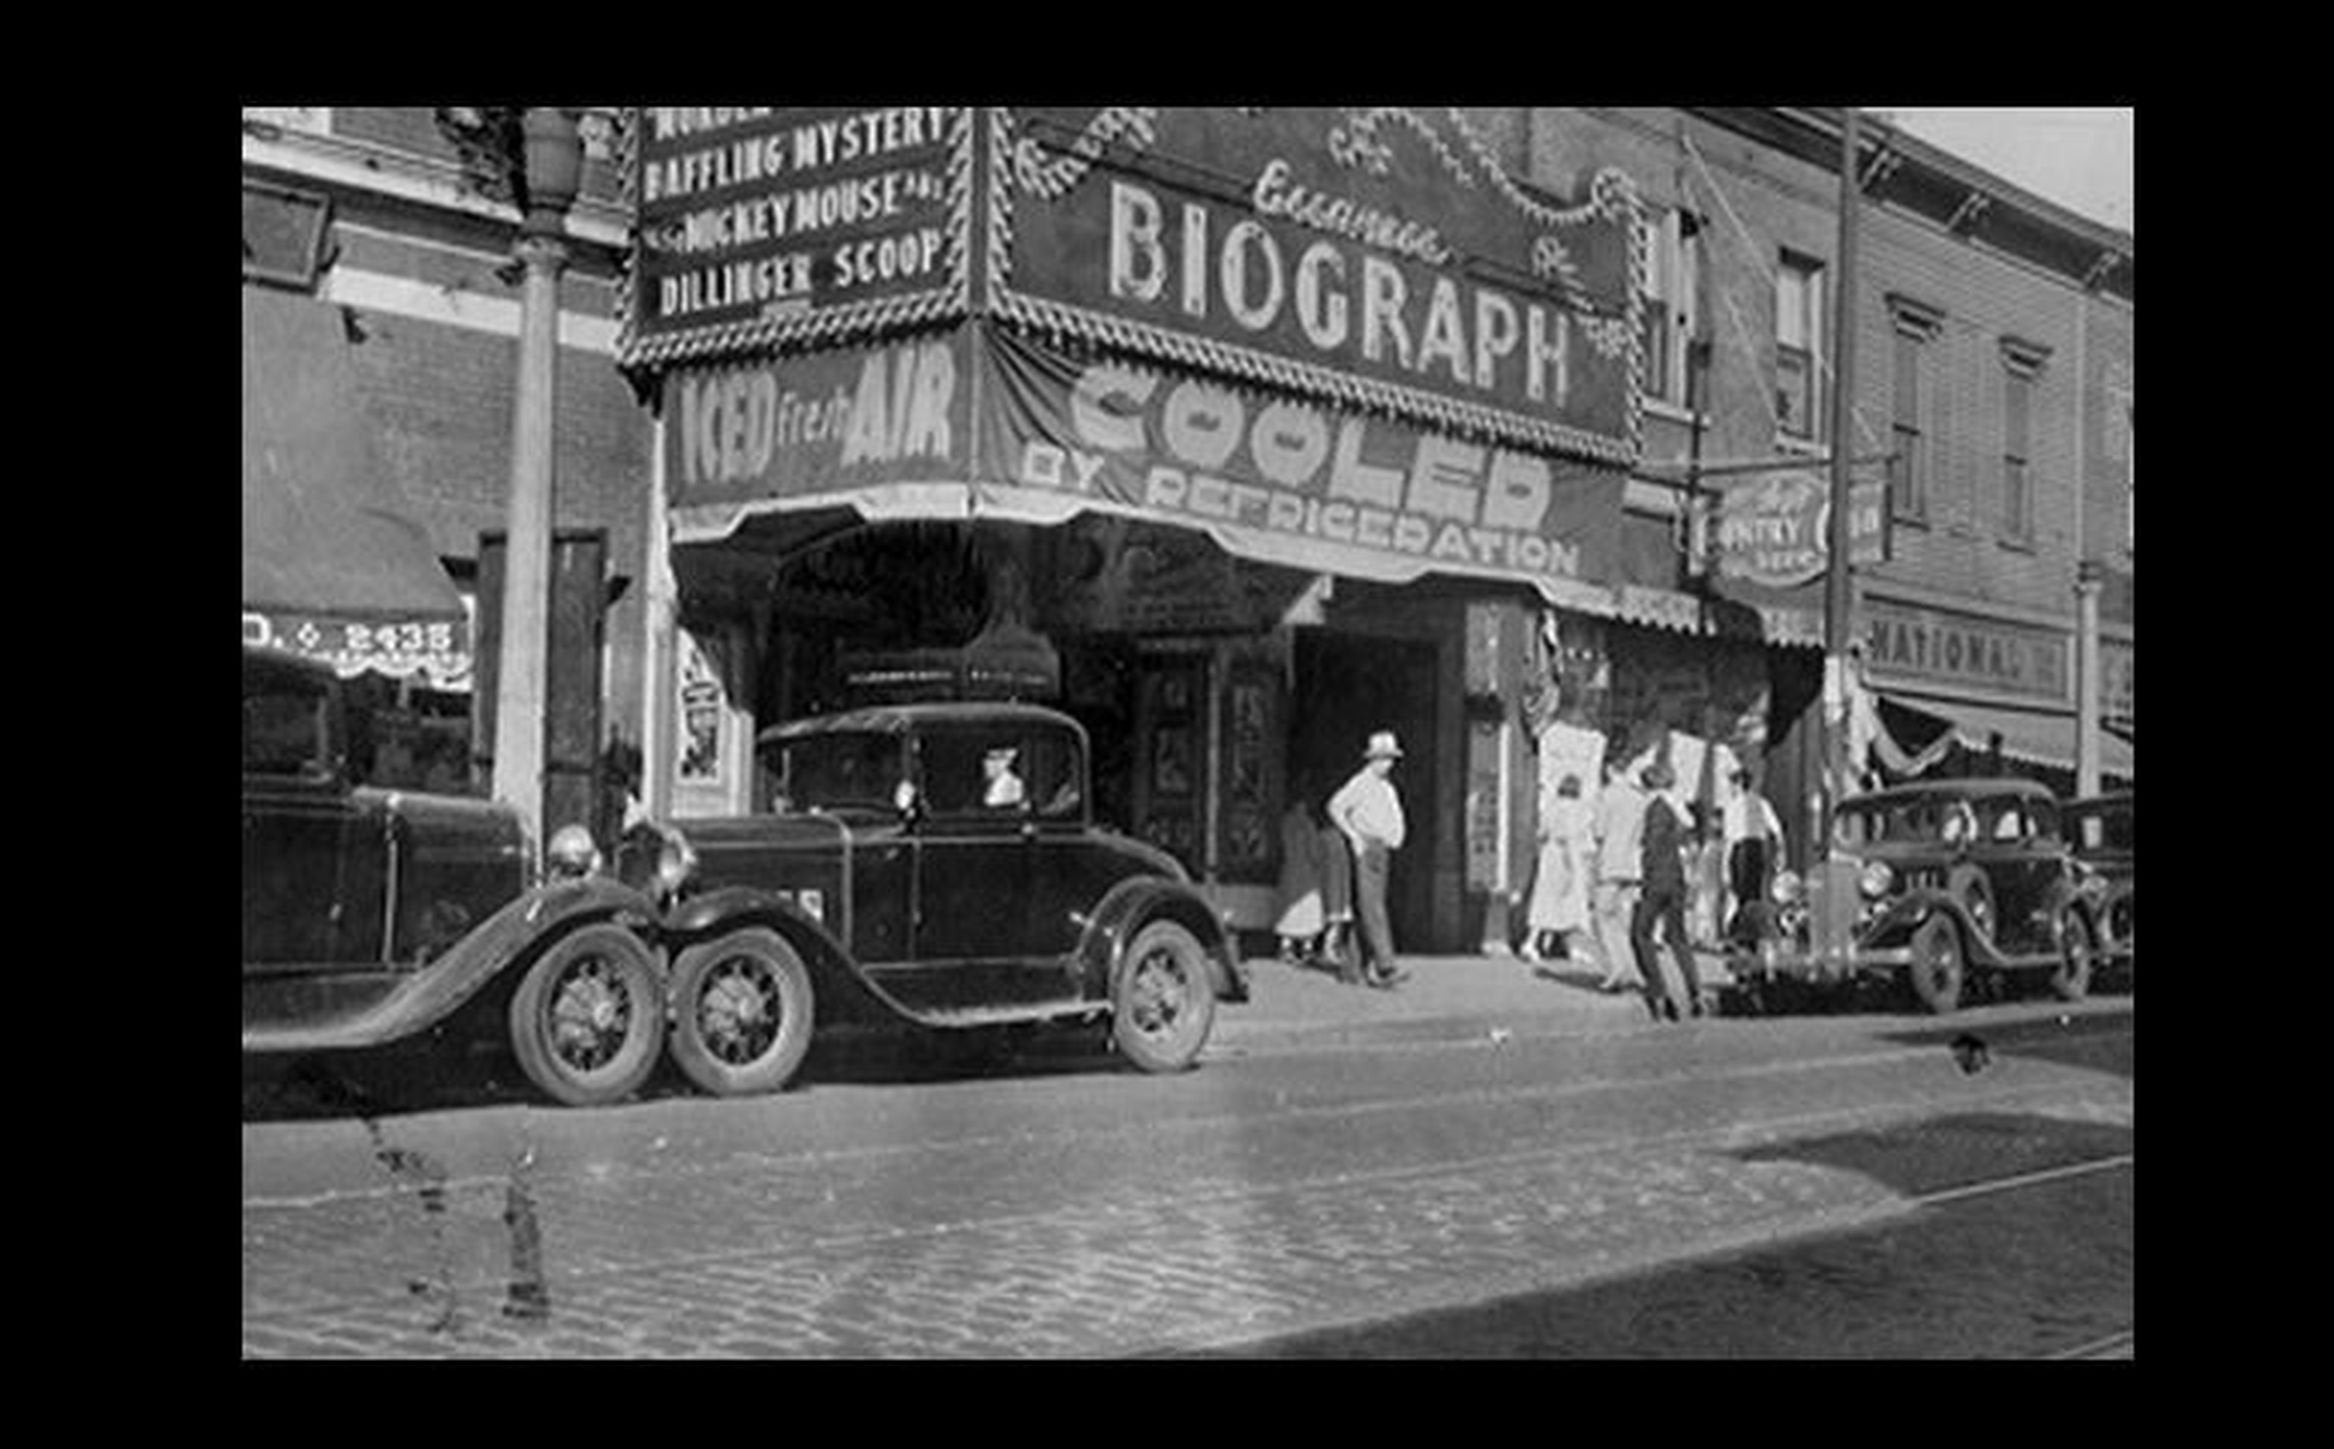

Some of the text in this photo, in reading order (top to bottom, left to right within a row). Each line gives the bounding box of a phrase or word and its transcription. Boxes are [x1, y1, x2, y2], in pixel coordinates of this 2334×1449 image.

[645, 107, 944, 201] BAFFLING MYSTERY
[685, 194, 791, 252] MICKEY
[794, 172, 902, 232] MOUSE
[660, 228, 942, 317] DILLINGER SCOOP
[1110, 180, 1570, 405] BIOGRAPH
[679, 367, 779, 487] ICED
[839, 341, 955, 468] AIR
[1071, 362, 1552, 531] COOLED
[1022, 441, 1579, 577] BY REFRIGERATION
